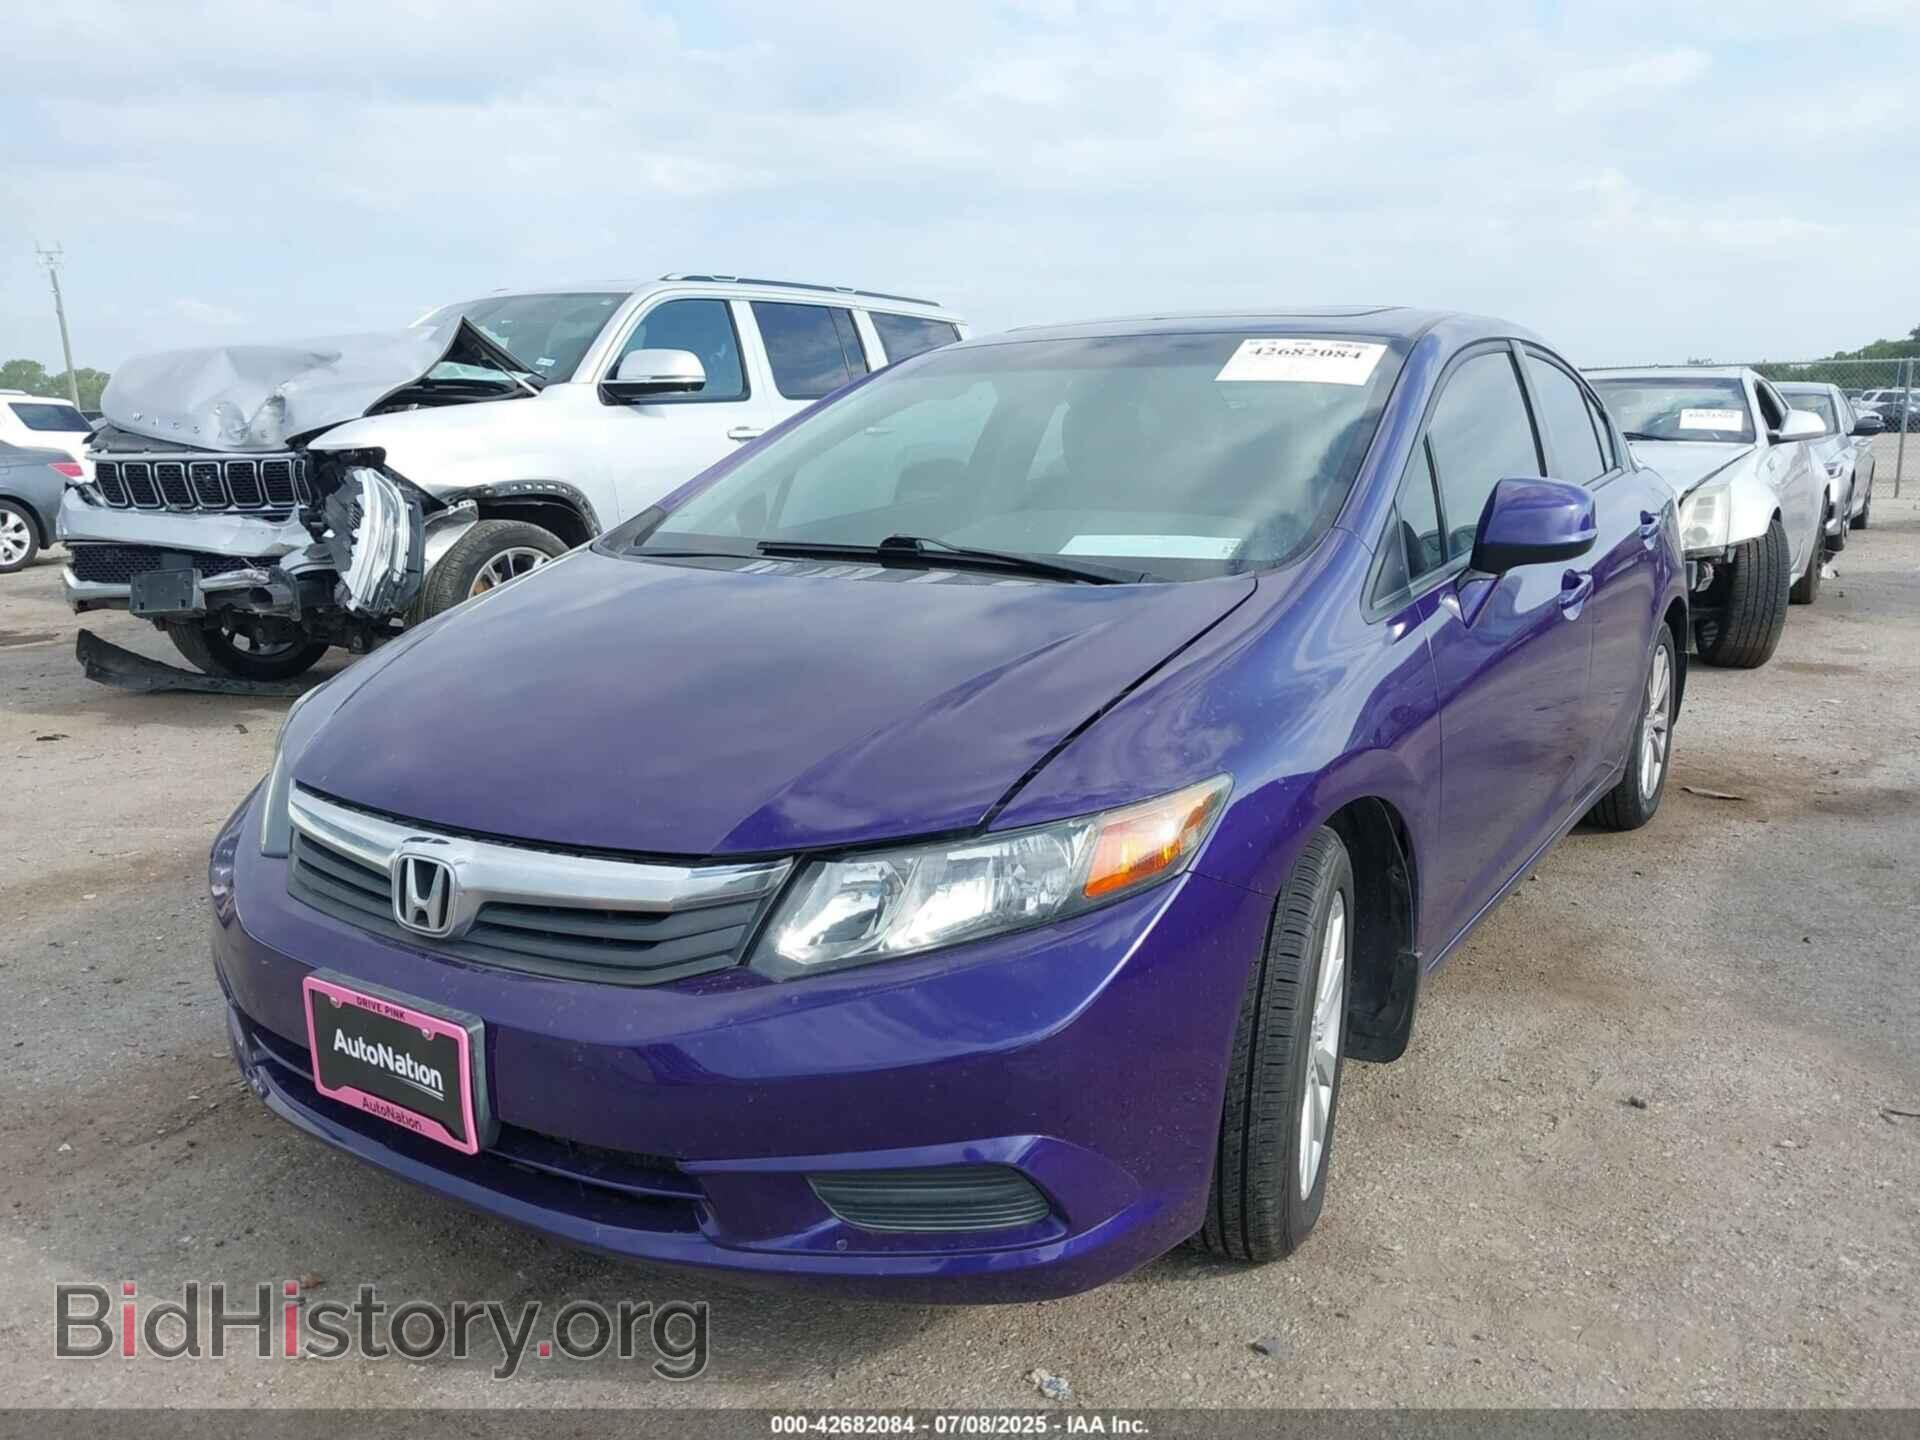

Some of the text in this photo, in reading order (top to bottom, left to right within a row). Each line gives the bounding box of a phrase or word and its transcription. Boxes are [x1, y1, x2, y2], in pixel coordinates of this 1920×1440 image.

[1248, 347, 1362, 360] 42682084
[356, 995, 406, 1020] DRIVE PINK
[333, 1027, 445, 1092] AutoNation
[362, 1097, 424, 1132] AutoNation
